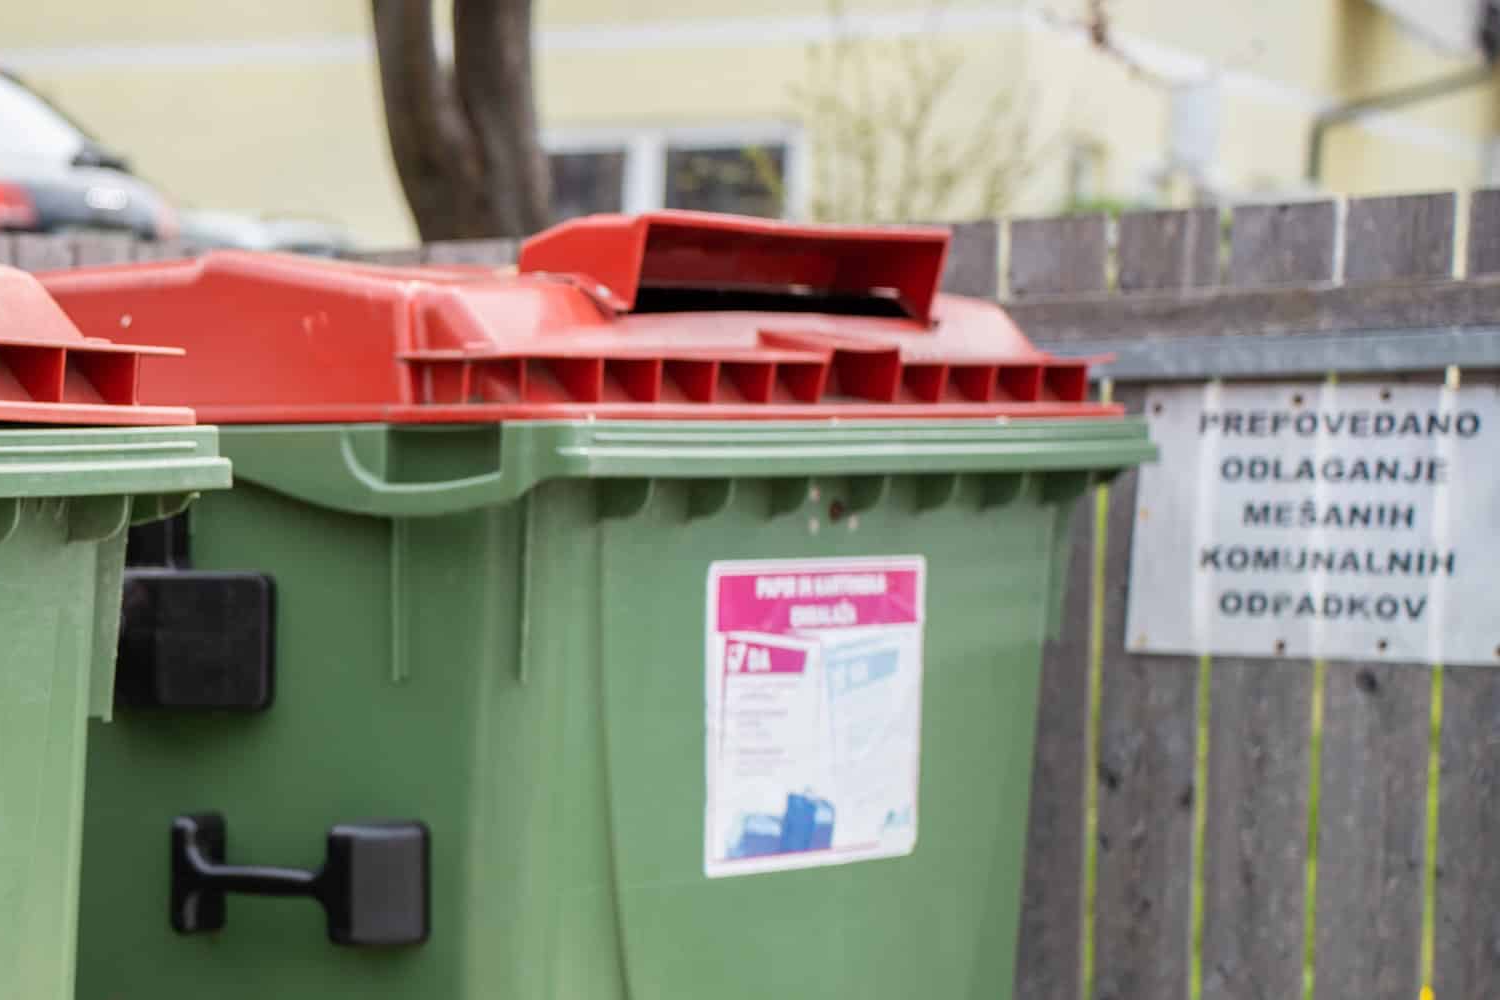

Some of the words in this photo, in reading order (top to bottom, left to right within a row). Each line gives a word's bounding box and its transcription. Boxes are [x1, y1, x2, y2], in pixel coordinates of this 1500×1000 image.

[1198, 410, 1482, 439] PREPOVEDANO
[1220, 456, 1448, 485] ODLAGANJE
[1242, 499, 1415, 529] MEŠANIH
[1198, 545, 1456, 577] KOMUNALNIH
[1218, 591, 1428, 621] ODPADKOV
